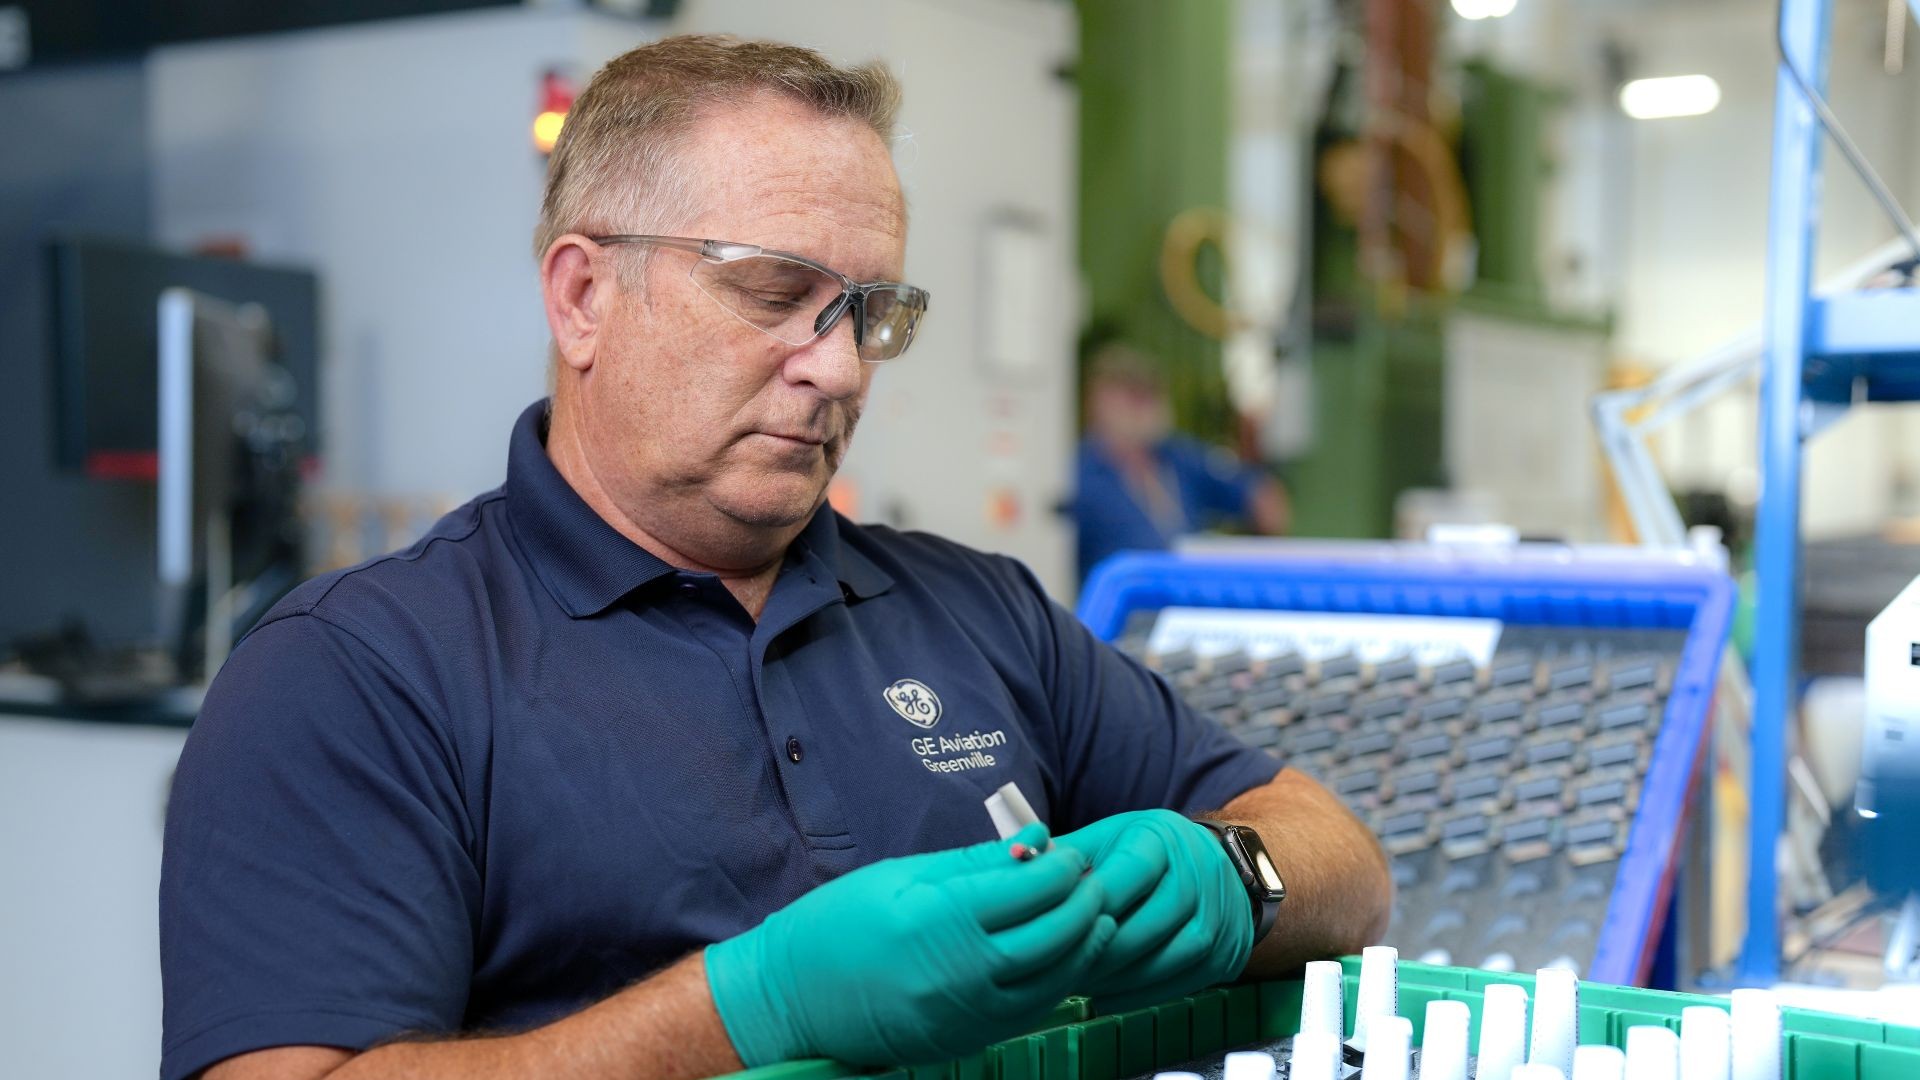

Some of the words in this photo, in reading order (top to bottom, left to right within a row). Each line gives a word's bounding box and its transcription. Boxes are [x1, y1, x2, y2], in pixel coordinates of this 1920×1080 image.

[911, 737, 939, 755] GE
[939, 730, 1007, 753] Aviation
[922, 752, 996, 773] Greenville
